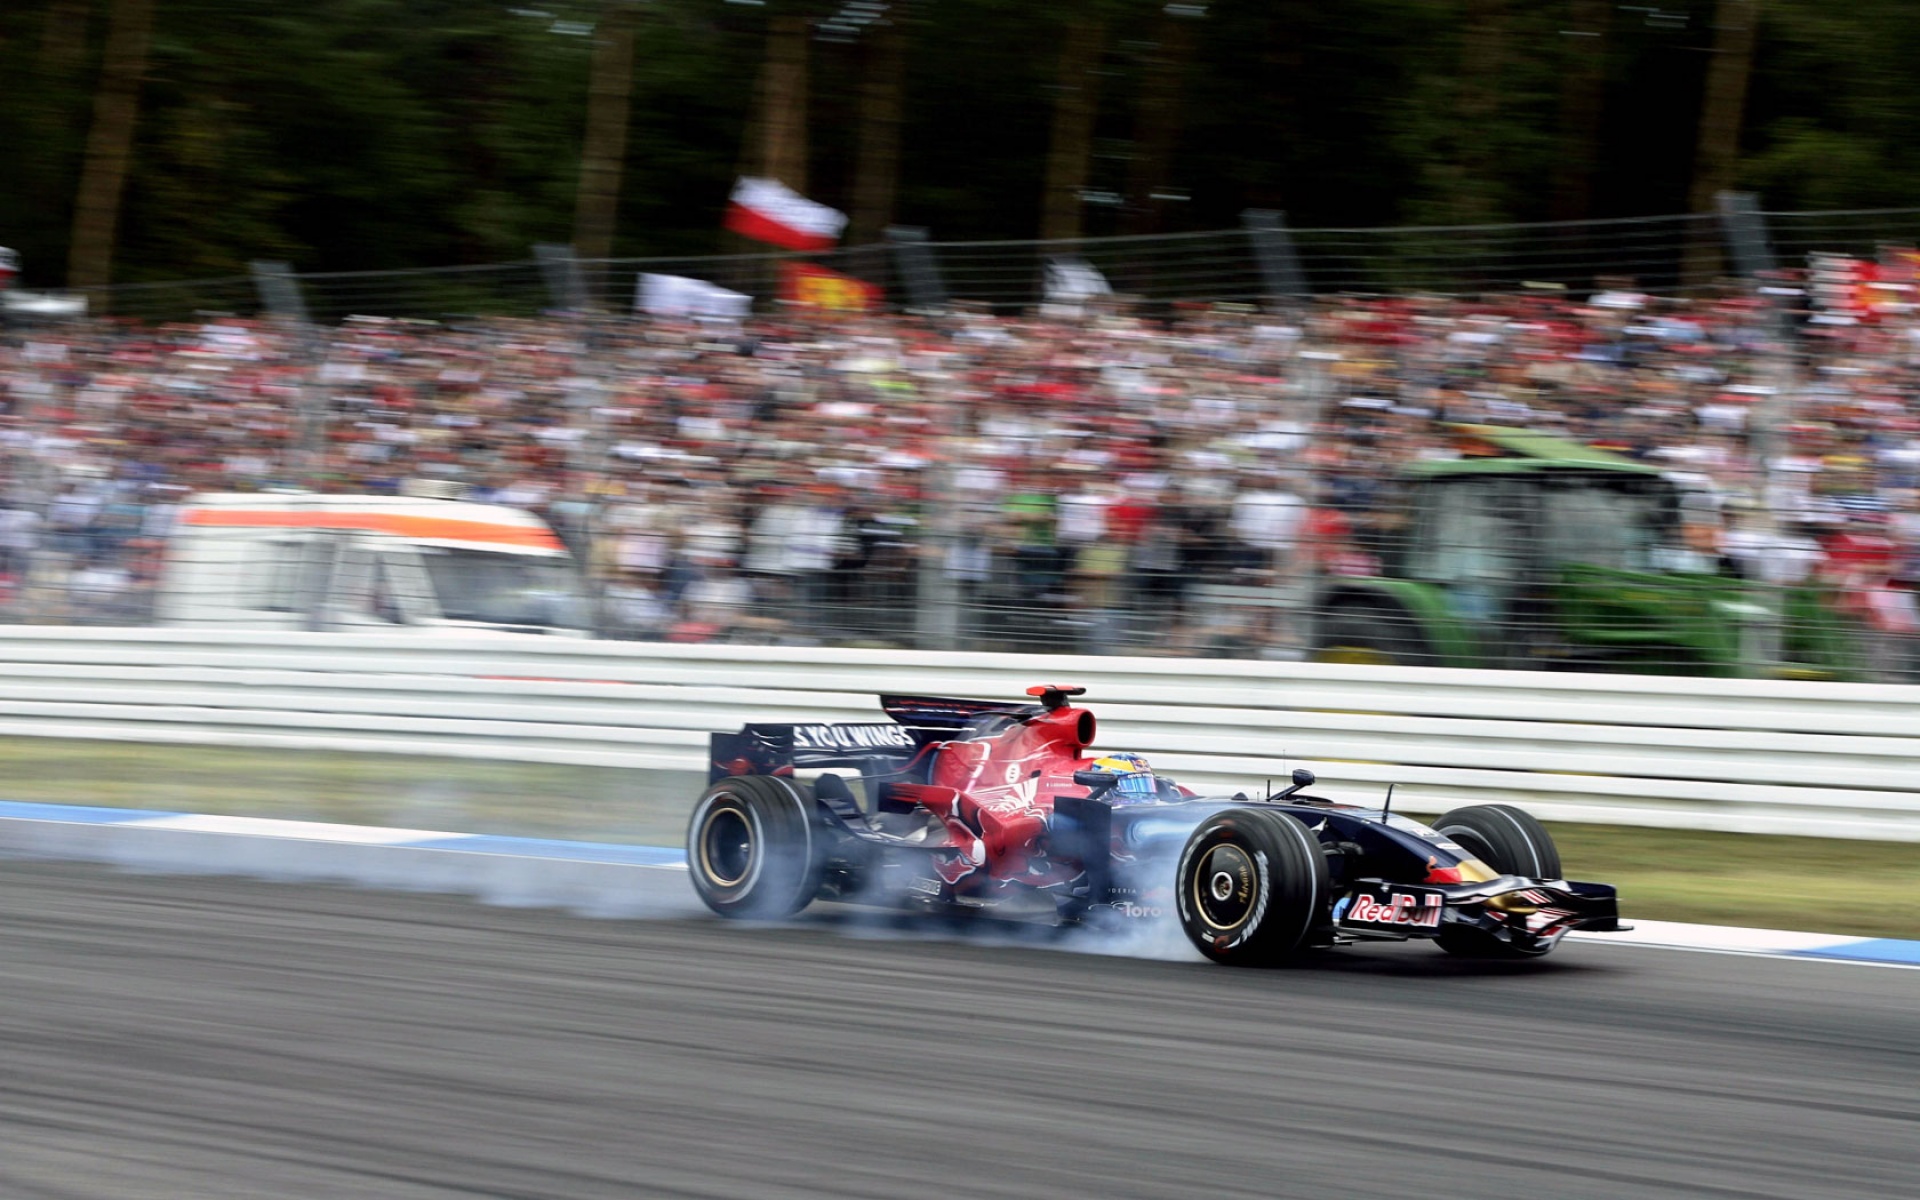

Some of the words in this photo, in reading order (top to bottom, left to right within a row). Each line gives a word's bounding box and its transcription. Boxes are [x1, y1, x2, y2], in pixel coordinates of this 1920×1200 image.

[805, 726, 851, 747] YOU
[848, 725, 916, 747] WINGS
[1122, 901, 1162, 918] Toro
[1348, 893, 1398, 922] Red
[1395, 893, 1442, 927] Bull
